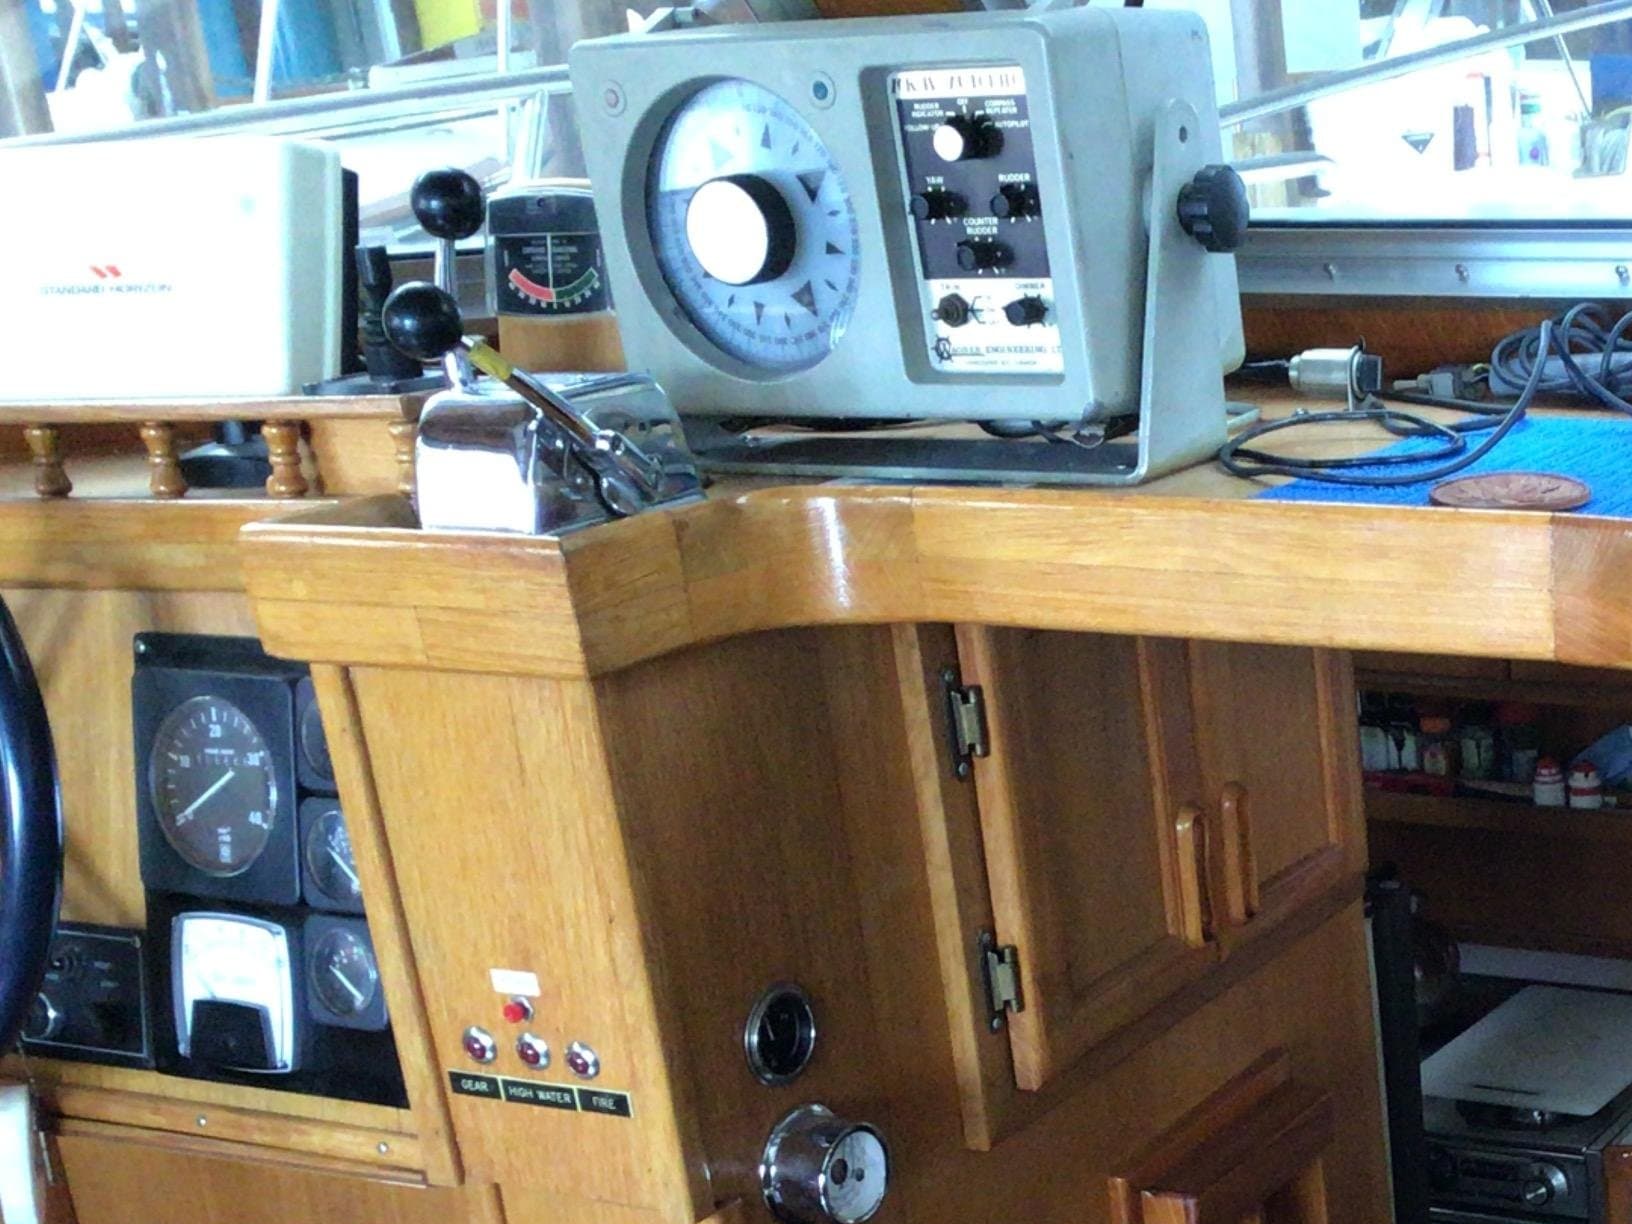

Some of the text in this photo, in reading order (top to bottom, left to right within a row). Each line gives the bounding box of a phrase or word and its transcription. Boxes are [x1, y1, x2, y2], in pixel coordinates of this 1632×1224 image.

[994, 119, 1029, 129] AUTOPILOT
[998, 173, 1032, 183] RUDDER
[963, 217, 999, 226] COUNTER
[966, 226, 998, 235] RUDDER
[209, 724, 222, 738] 20
[461, 1079, 489, 1092] GEAR
[508, 1085, 572, 1104] HIGH WATER
[591, 1096, 617, 1110] FIRE
